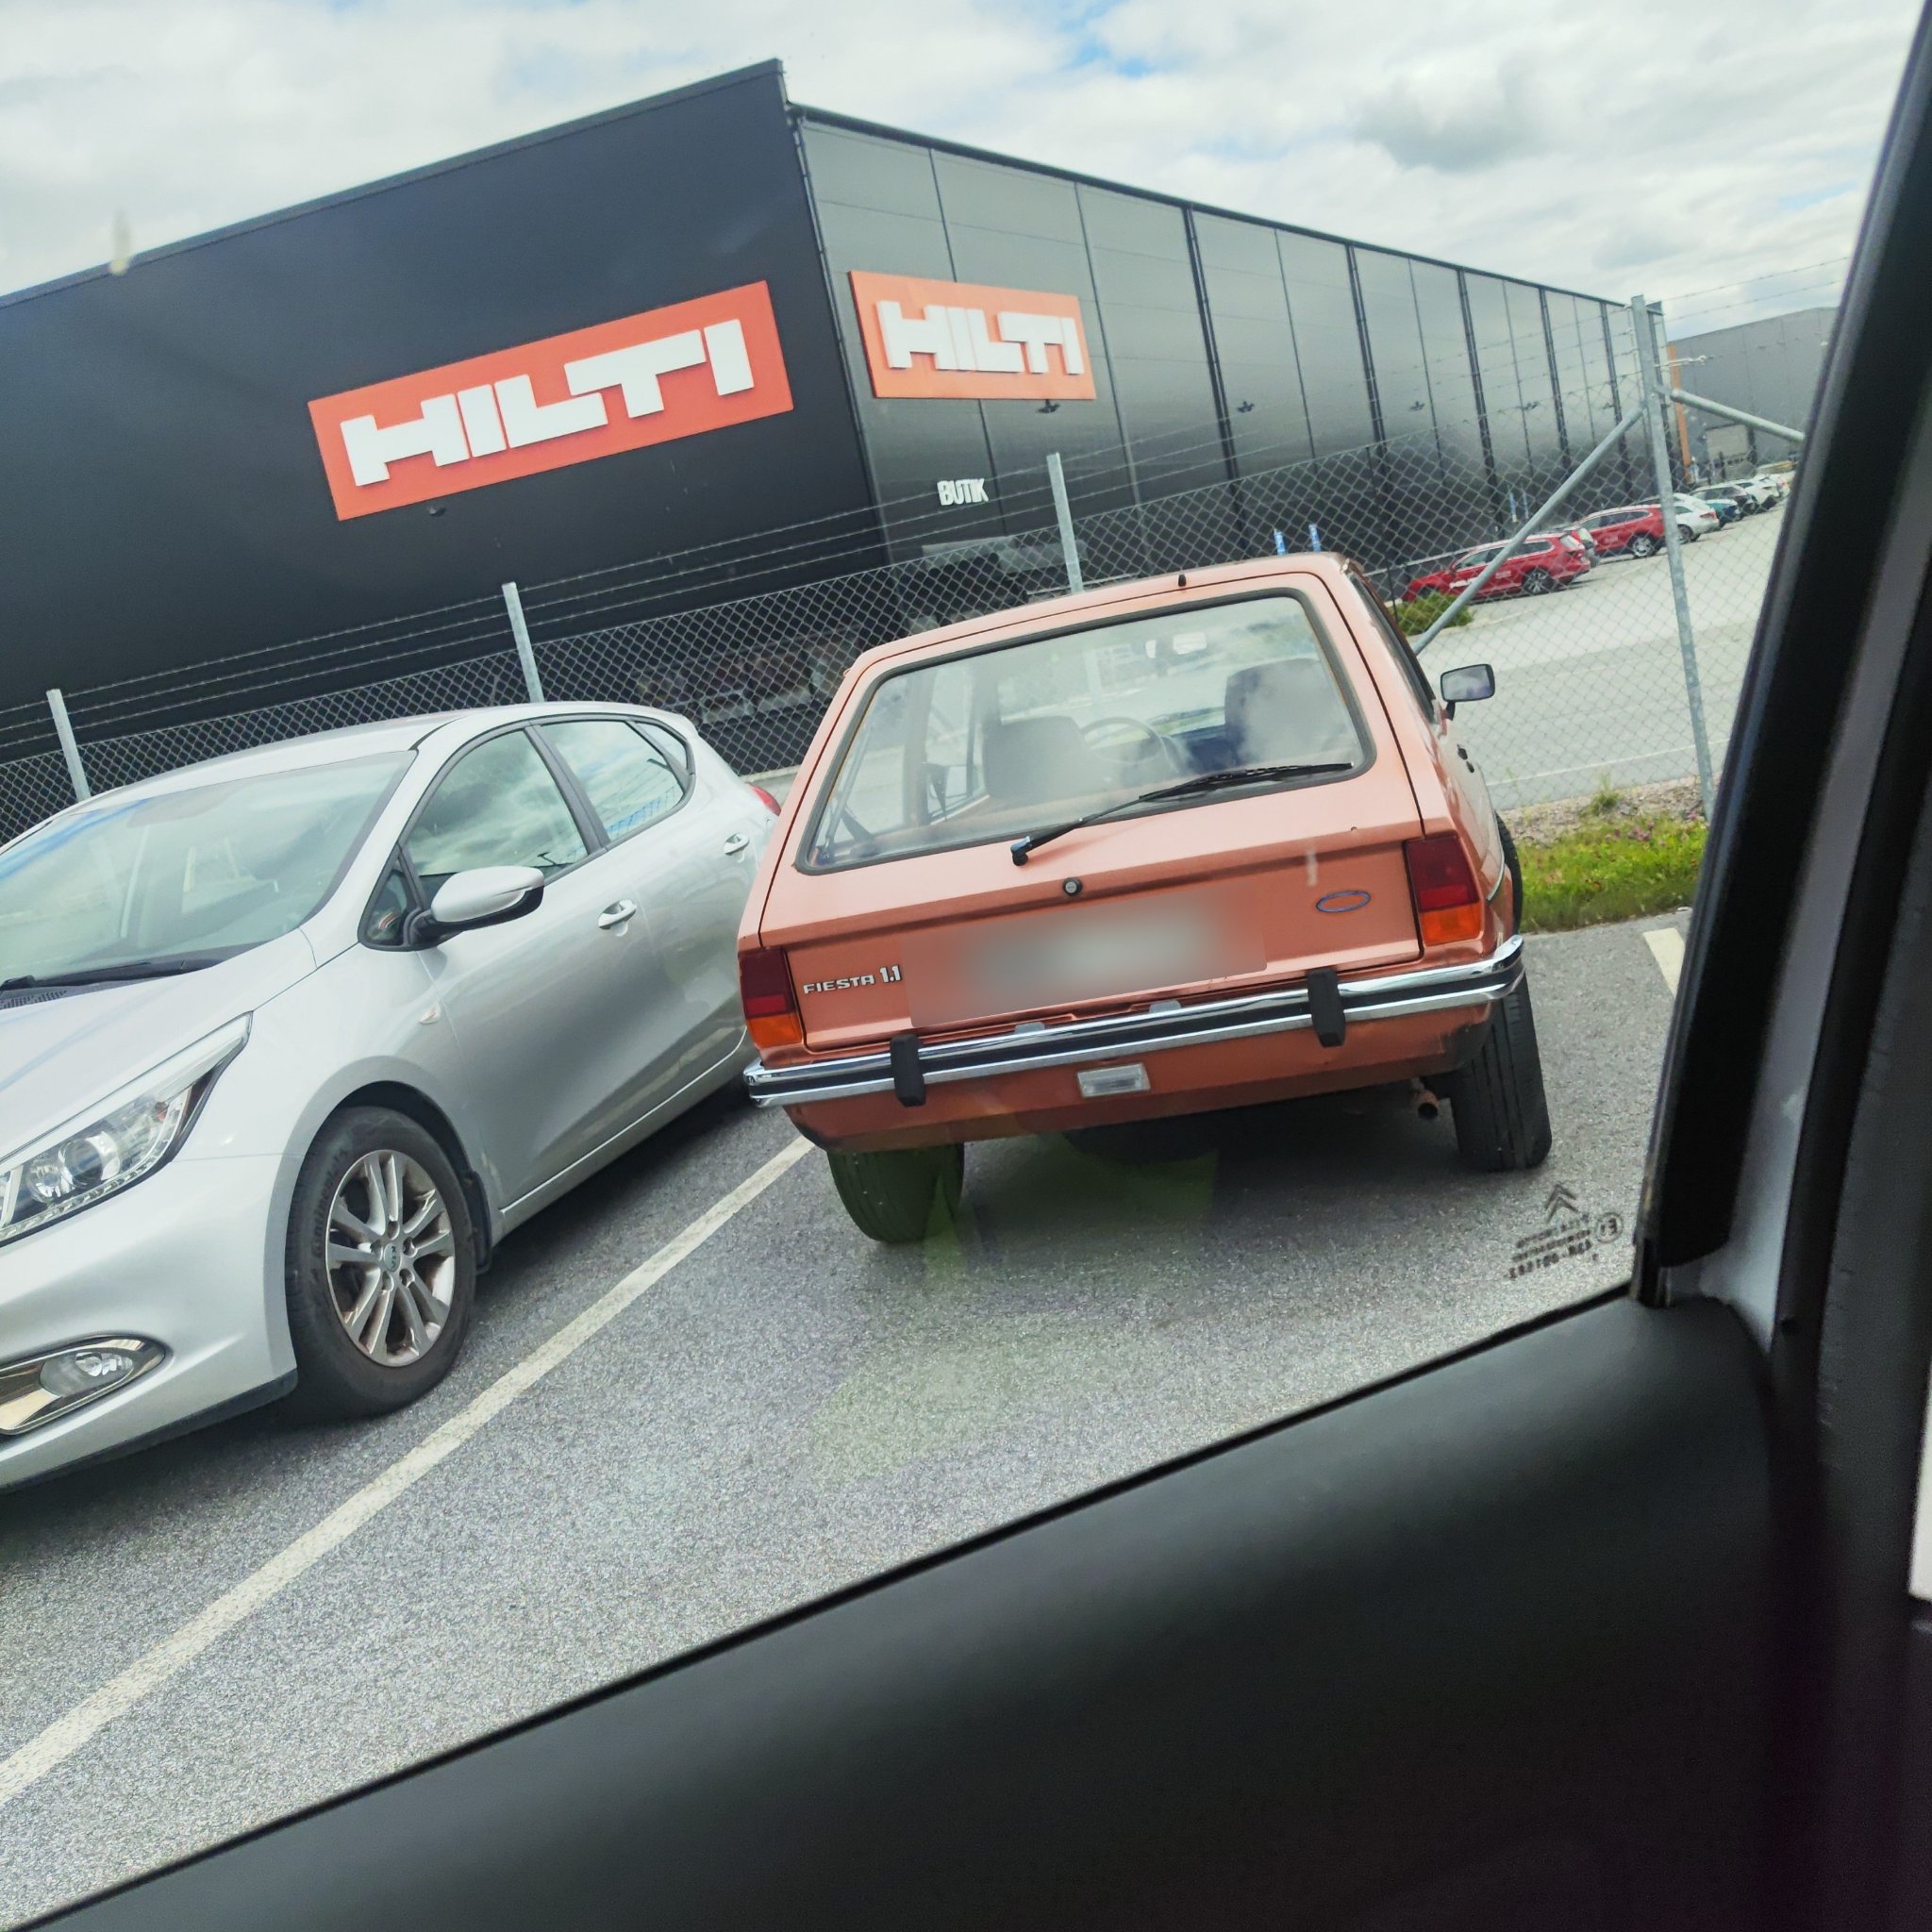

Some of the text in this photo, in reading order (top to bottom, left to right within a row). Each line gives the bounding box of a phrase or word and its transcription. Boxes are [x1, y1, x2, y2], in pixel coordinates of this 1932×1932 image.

[876, 300, 1085, 375] HILTI
[340, 319, 755, 487] HILTI
[937, 478, 989, 506] BUTIK
[803, 965, 901, 994] FIESTA 1.1
